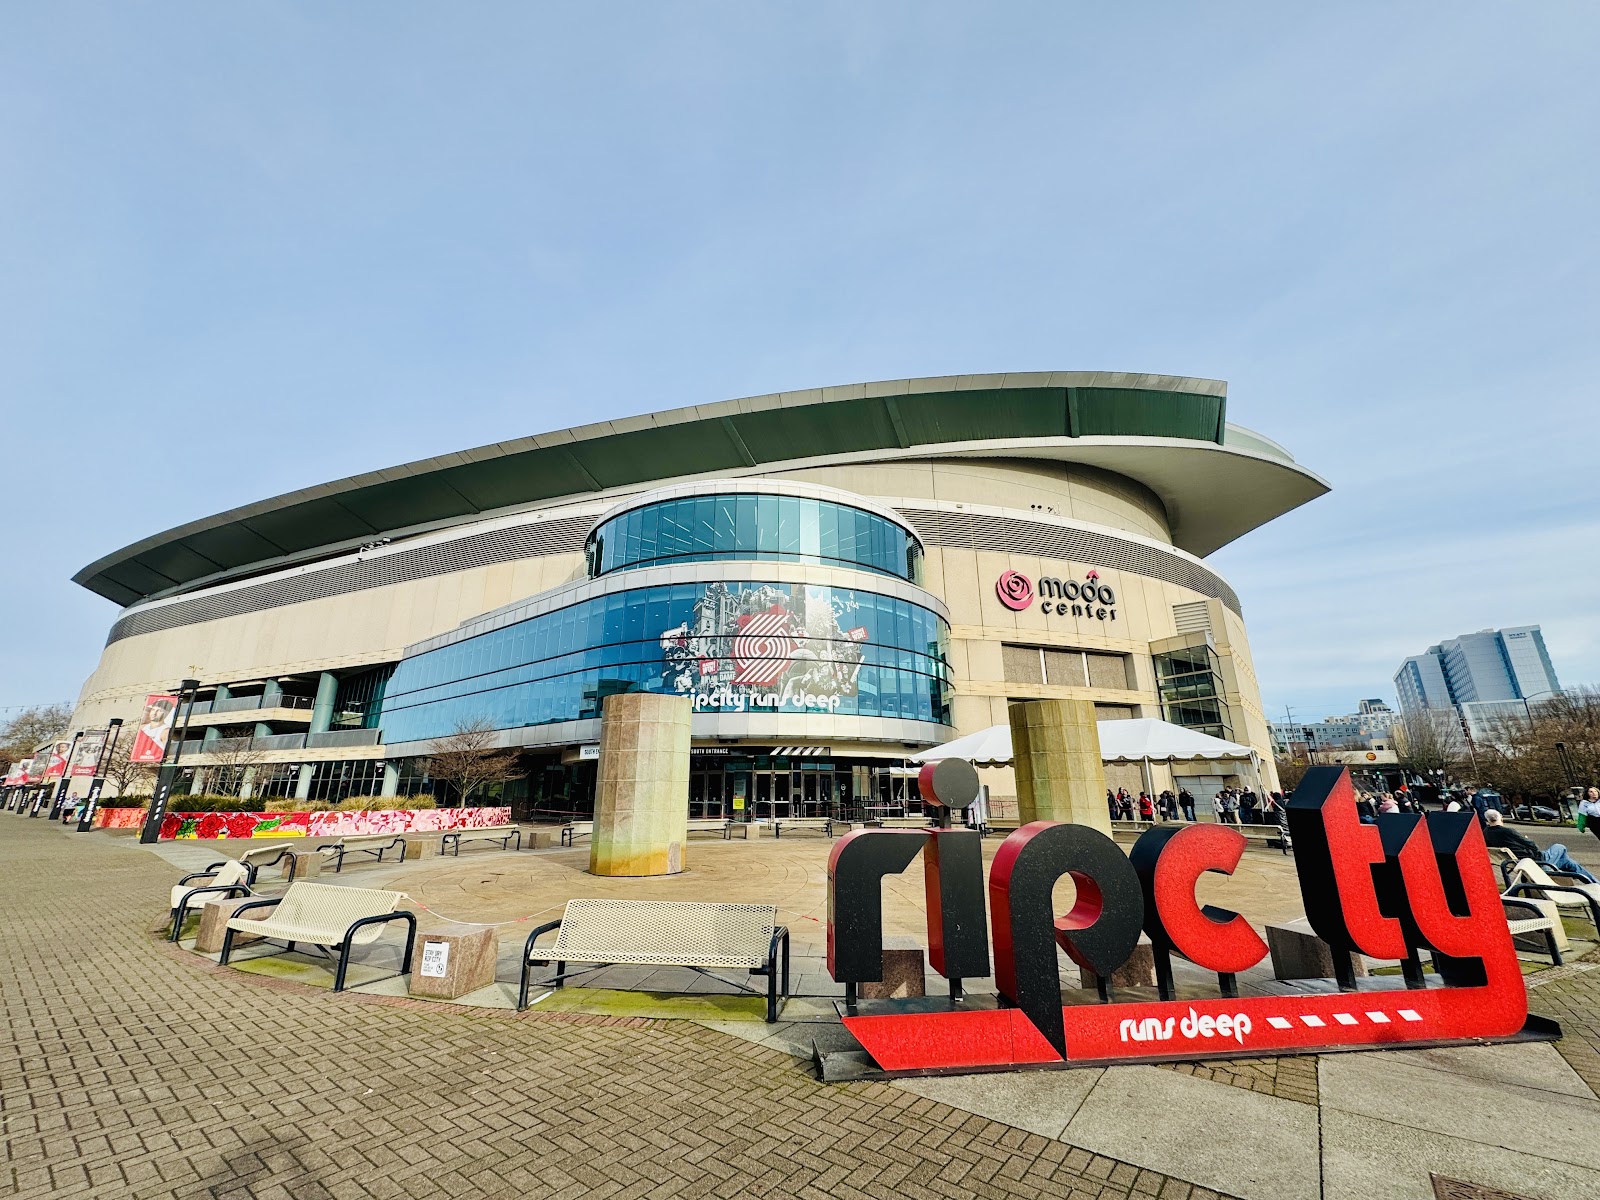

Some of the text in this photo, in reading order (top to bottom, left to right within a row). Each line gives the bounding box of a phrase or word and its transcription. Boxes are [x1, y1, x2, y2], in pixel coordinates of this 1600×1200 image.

[1039, 570, 1116, 606] moda
[1041, 600, 1117, 621] center
[750, 691, 792, 707] runs
[791, 689, 841, 713] deep
[1119, 1006, 1253, 1045] runs deep
